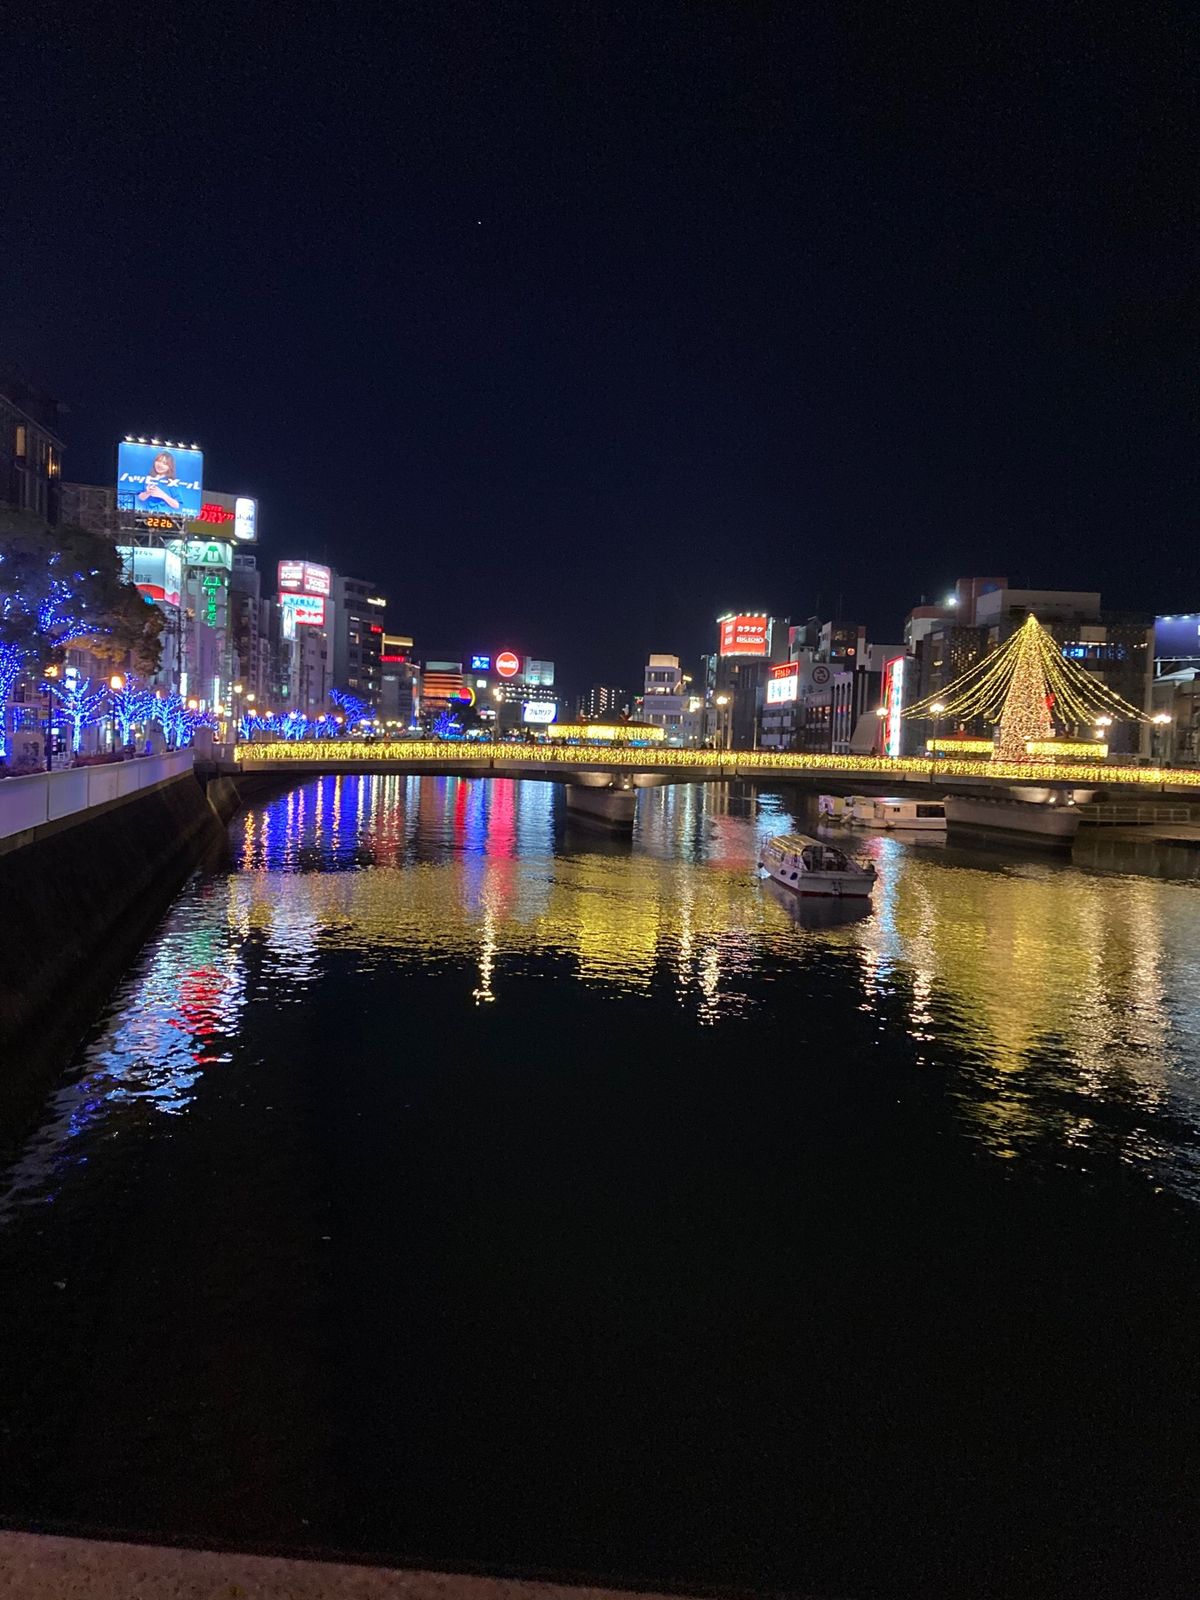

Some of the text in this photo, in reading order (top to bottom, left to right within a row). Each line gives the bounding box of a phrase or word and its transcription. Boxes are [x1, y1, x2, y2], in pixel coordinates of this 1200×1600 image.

[120, 472, 200, 490] ハッピーメール
[736, 625, 764, 633] カラオケ
